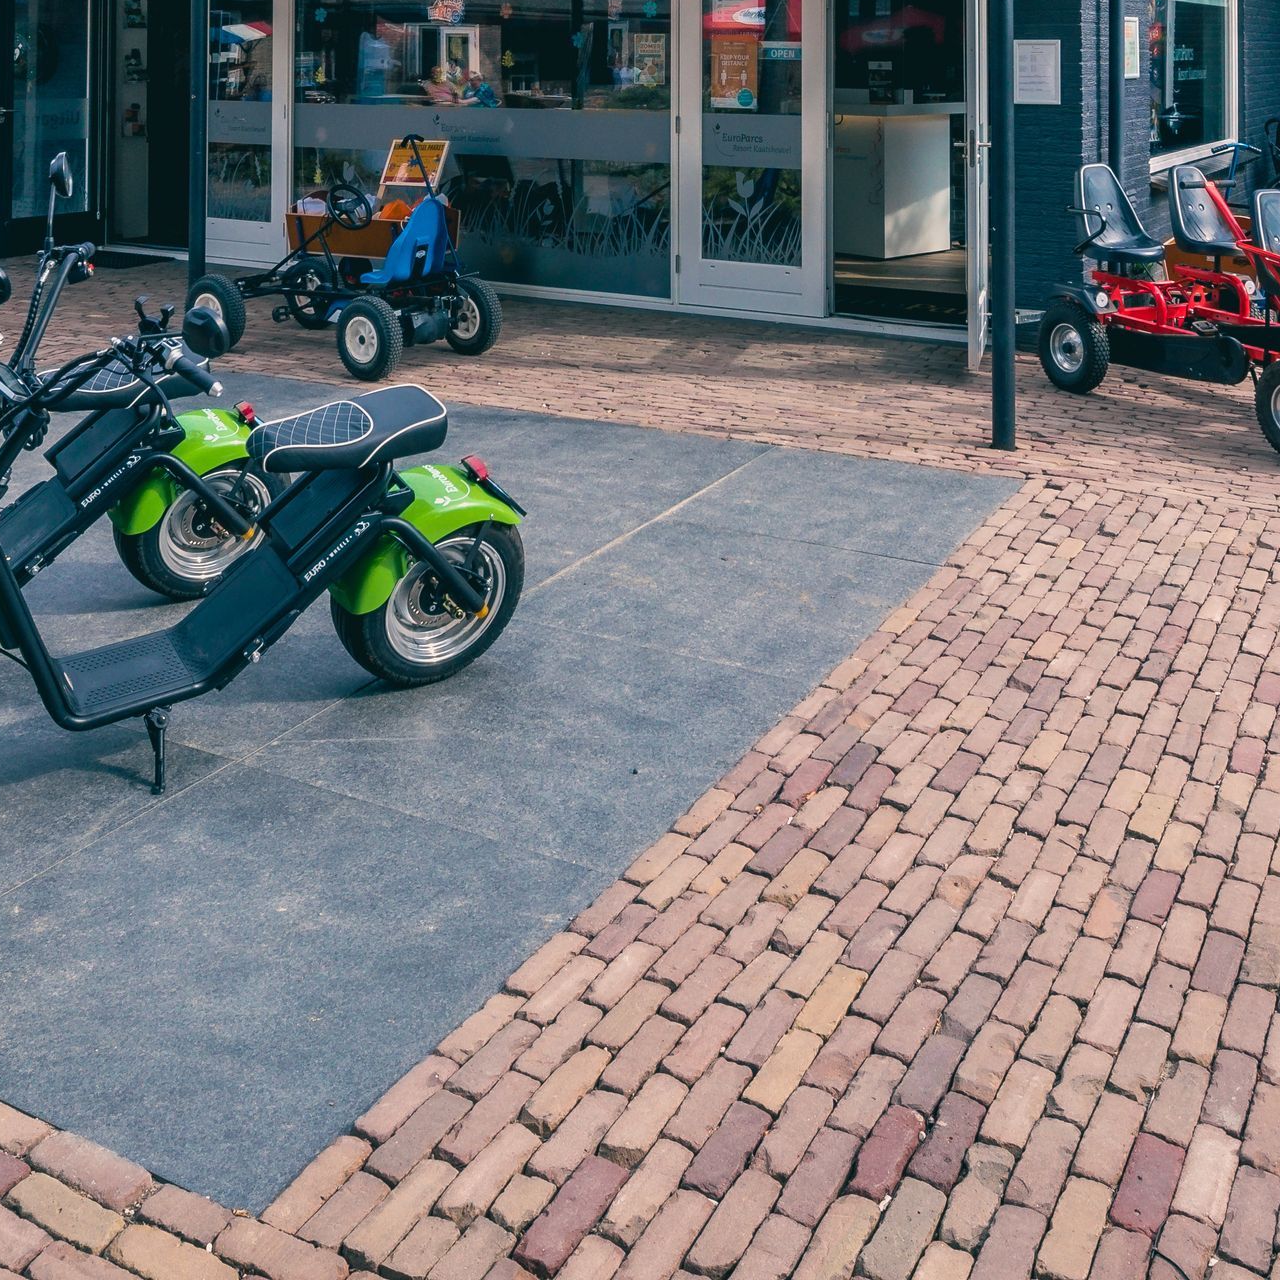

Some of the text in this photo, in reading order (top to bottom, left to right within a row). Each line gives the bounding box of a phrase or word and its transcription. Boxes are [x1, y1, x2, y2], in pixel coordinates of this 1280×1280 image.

[770, 49, 795, 58] OPEN
[722, 133, 763, 143] EuroParcs
[422, 464, 458, 493] EuroParcs
[81, 488, 101, 508] EURO
[304, 559, 326, 582] EURO
